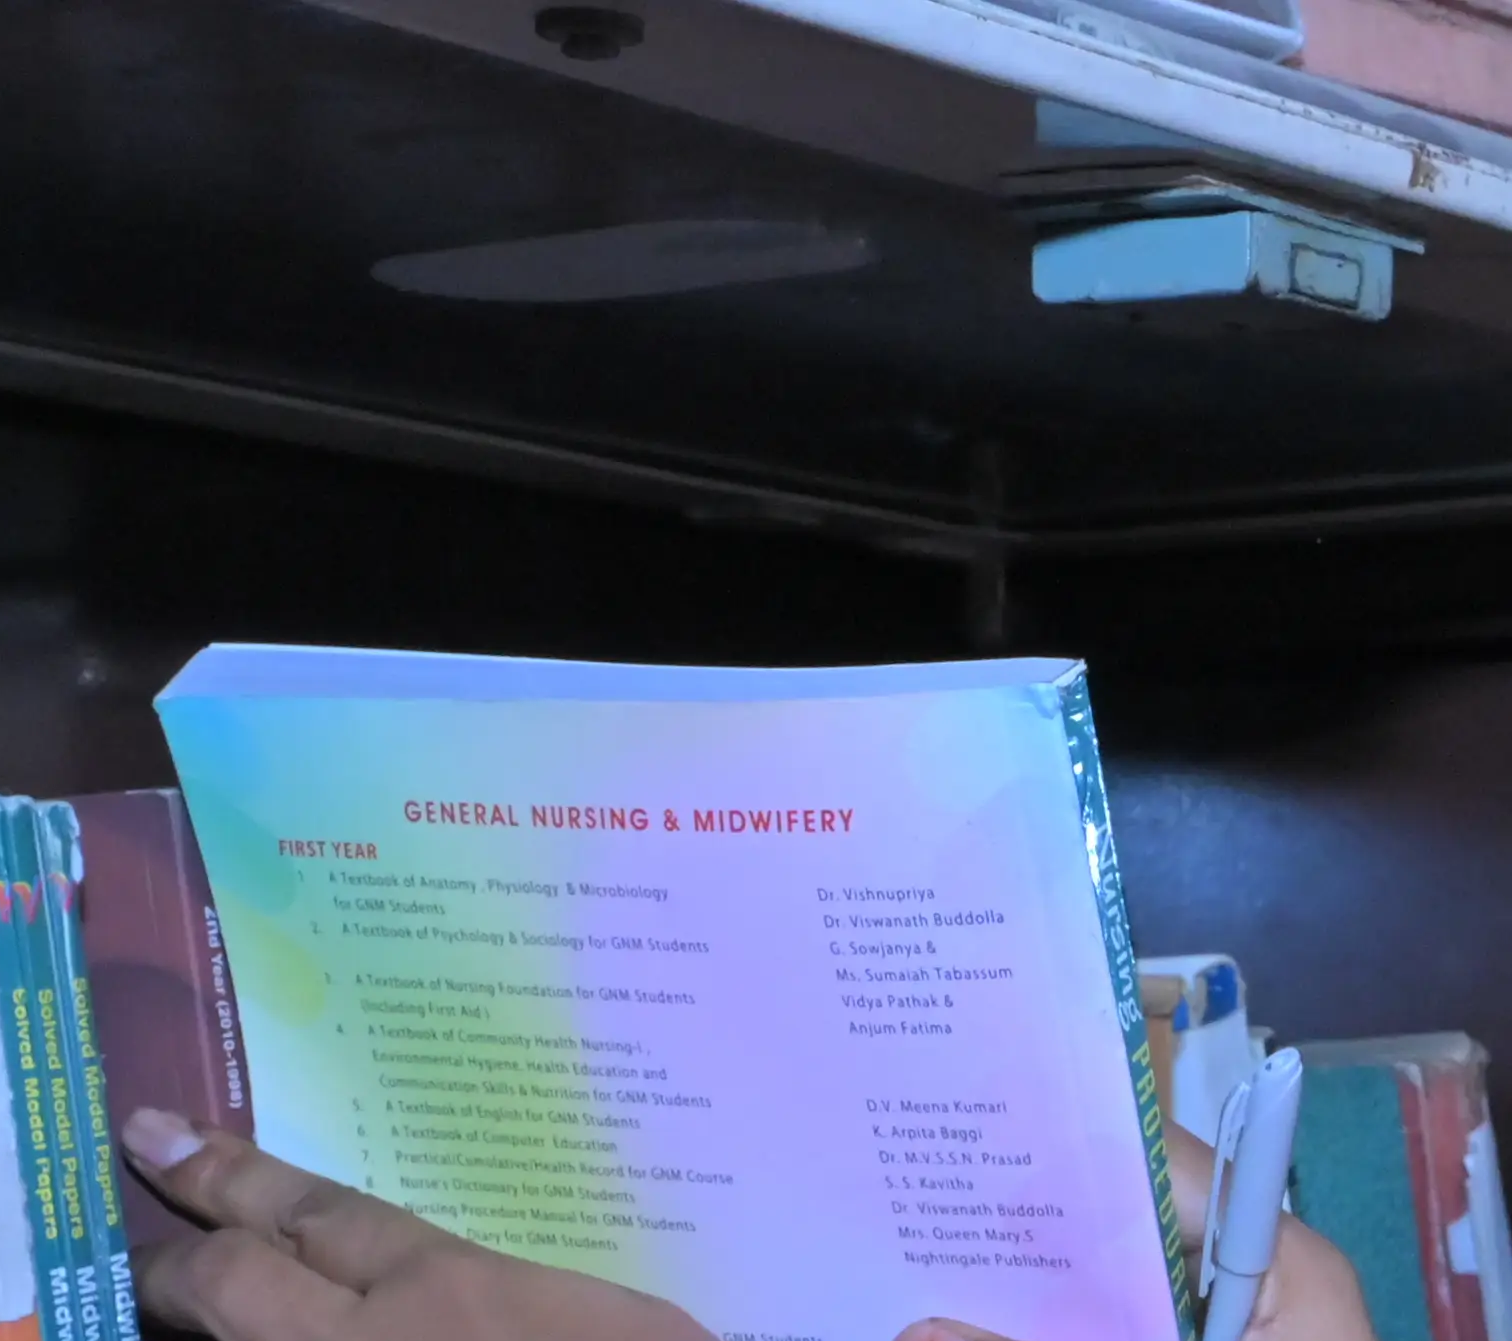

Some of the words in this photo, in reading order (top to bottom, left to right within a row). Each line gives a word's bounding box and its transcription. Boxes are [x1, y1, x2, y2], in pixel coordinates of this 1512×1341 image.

[404, 799, 519, 828] GENERAL
[532, 804, 649, 832] NURSING
[663, 808, 681, 832] &
[693, 808, 854, 833] MIDWIFERY
[278, 839, 326, 858] FIRST
[331, 842, 377, 860] YEAR
[341, 873, 399, 887] Textbook
[403, 875, 416, 888] of
[420, 876, 477, 893] Anatomy
[580, 882, 668, 901] Microbiology
[817, 888, 840, 902] Dr.
[842, 887, 936, 903] Vishnupriya
[334, 897, 351, 910] for
[355, 899, 385, 912] GNM
[388, 899, 445, 915] Students
[849, 913, 929, 928] Viswanath
[934, 909, 1005, 927] Buddolla
[353, 925, 413, 939] Textbook
[432, 927, 505, 946] Psychology
[521, 932, 584, 950] Sociology
[588, 935, 607, 950] for
[611, 936, 643, 950] GNM
[648, 938, 709, 953] Students
[849, 941, 922, 958] Sowjanya
[926, 941, 936, 954] &
[211, 953, 226, 996] Year
[836, 969, 861, 982] Ms.
[865, 968, 930, 982] Sumaiah
[934, 966, 1013, 981] Tabassum
[842, 995, 883, 1011] Vidya
[887, 994, 939, 1008] Pathak
[944, 995, 954, 1007] &
[39, 989, 62, 1070] Solved
[849, 1022, 896, 1038] Anjum
[900, 1022, 952, 1035] Fatima
[1094, 825, 1143, 1032] Nursing
[1132, 1040, 1190, 1322] PROCEDURE
[51, 1078, 74, 1151] Model
[879, 1150, 900, 1164] Dr.
[982, 1152, 1032, 1166] Prasad
[62, 1158, 83, 1239] Papers
[898, 1227, 928, 1240] Mrs.
[932, 1228, 980, 1240] Queen
[904, 1252, 991, 1268] Nightingale
[995, 1254, 1072, 1268] Publishers
